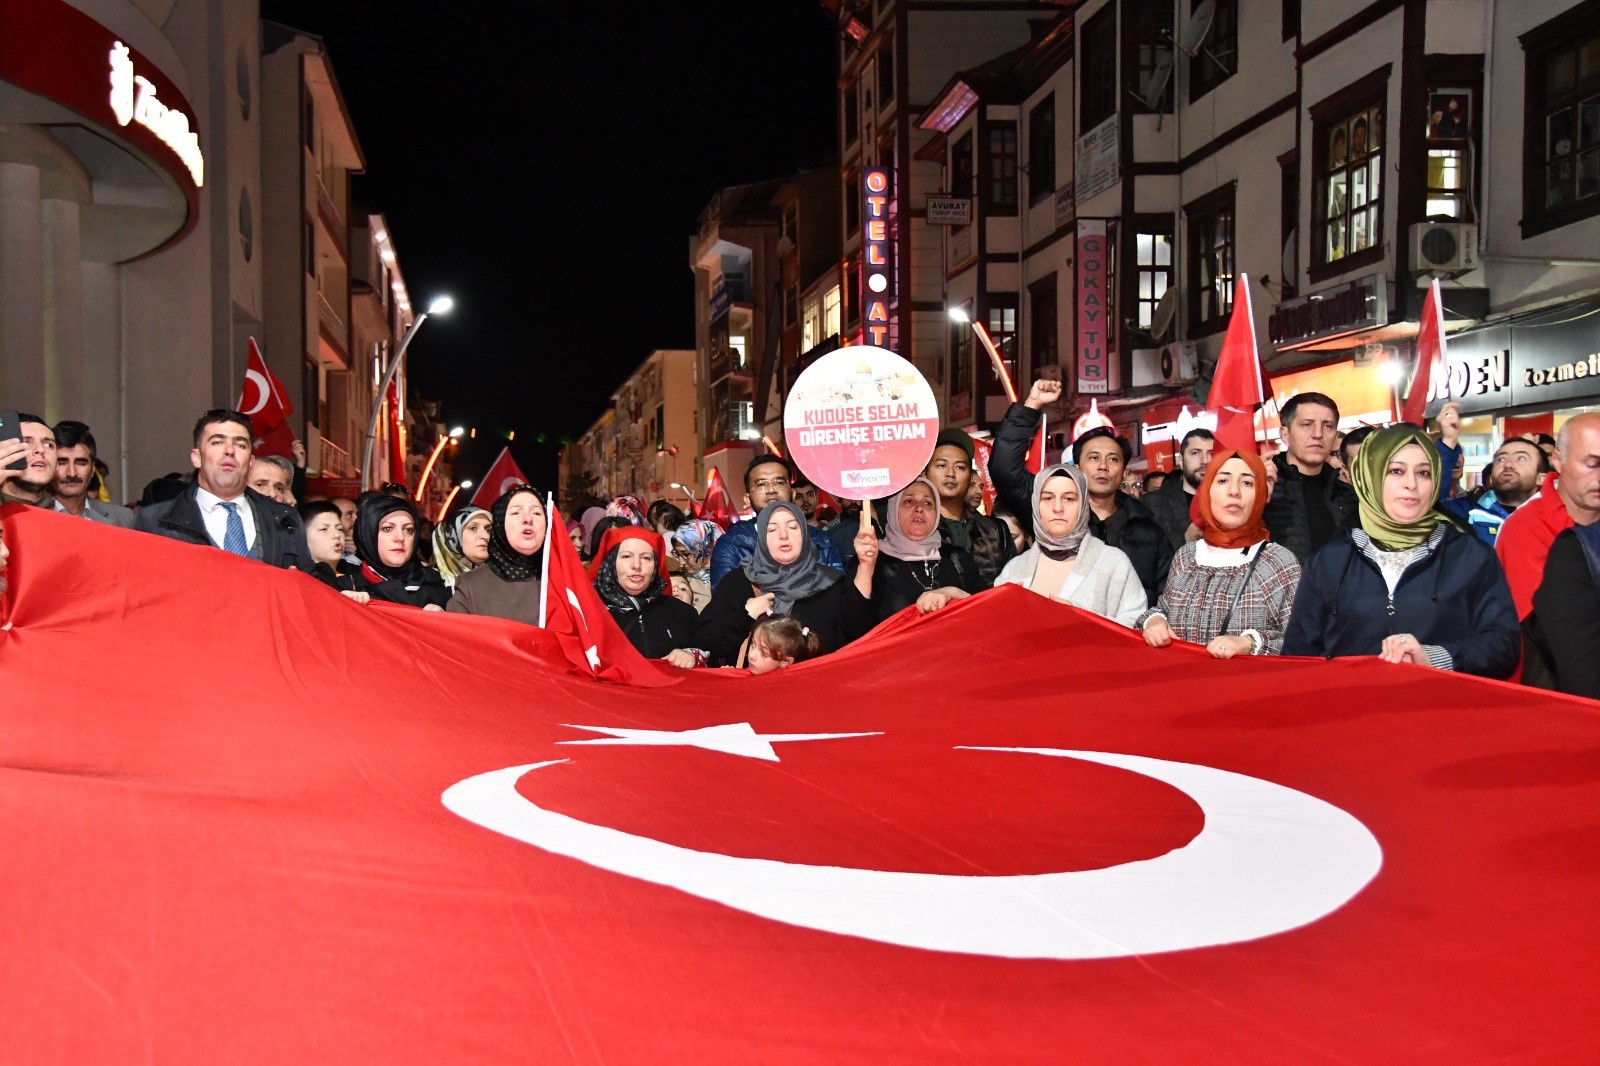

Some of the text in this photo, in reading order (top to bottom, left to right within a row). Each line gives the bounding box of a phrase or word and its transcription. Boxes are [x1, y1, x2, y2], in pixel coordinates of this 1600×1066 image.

[867, 171, 887, 265] OTEL
[932, 202, 966, 210] AVUKAT
[1082, 240, 1101, 377] GÖKAY TUR
[868, 402, 919, 421] SELAM
[799, 422, 926, 447] DİRENİŞE DEVAM
